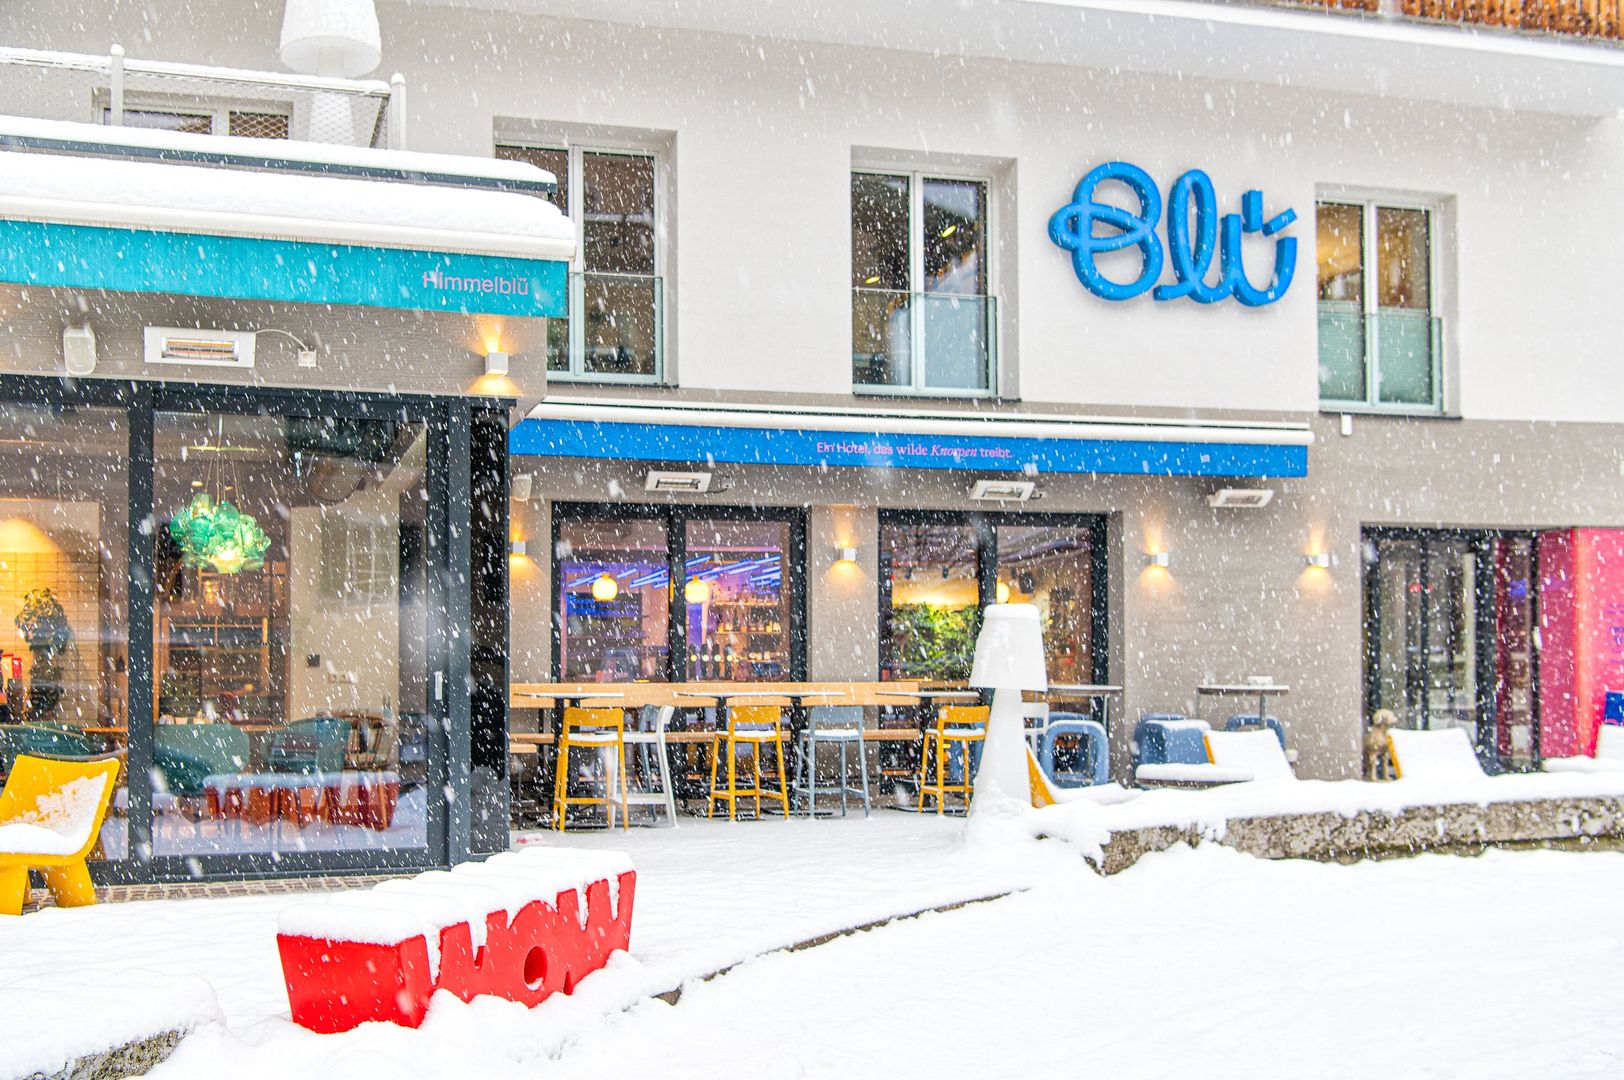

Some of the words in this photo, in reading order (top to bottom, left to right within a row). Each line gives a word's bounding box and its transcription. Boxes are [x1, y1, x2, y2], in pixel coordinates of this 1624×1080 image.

[422, 271, 529, 296] Himmelblü
[816, 441, 834, 454] Ein
[836, 442, 871, 456] Hotel,
[873, 444, 894, 455] das
[896, 444, 928, 457] wilde
[979, 446, 1014, 459] treibt.
